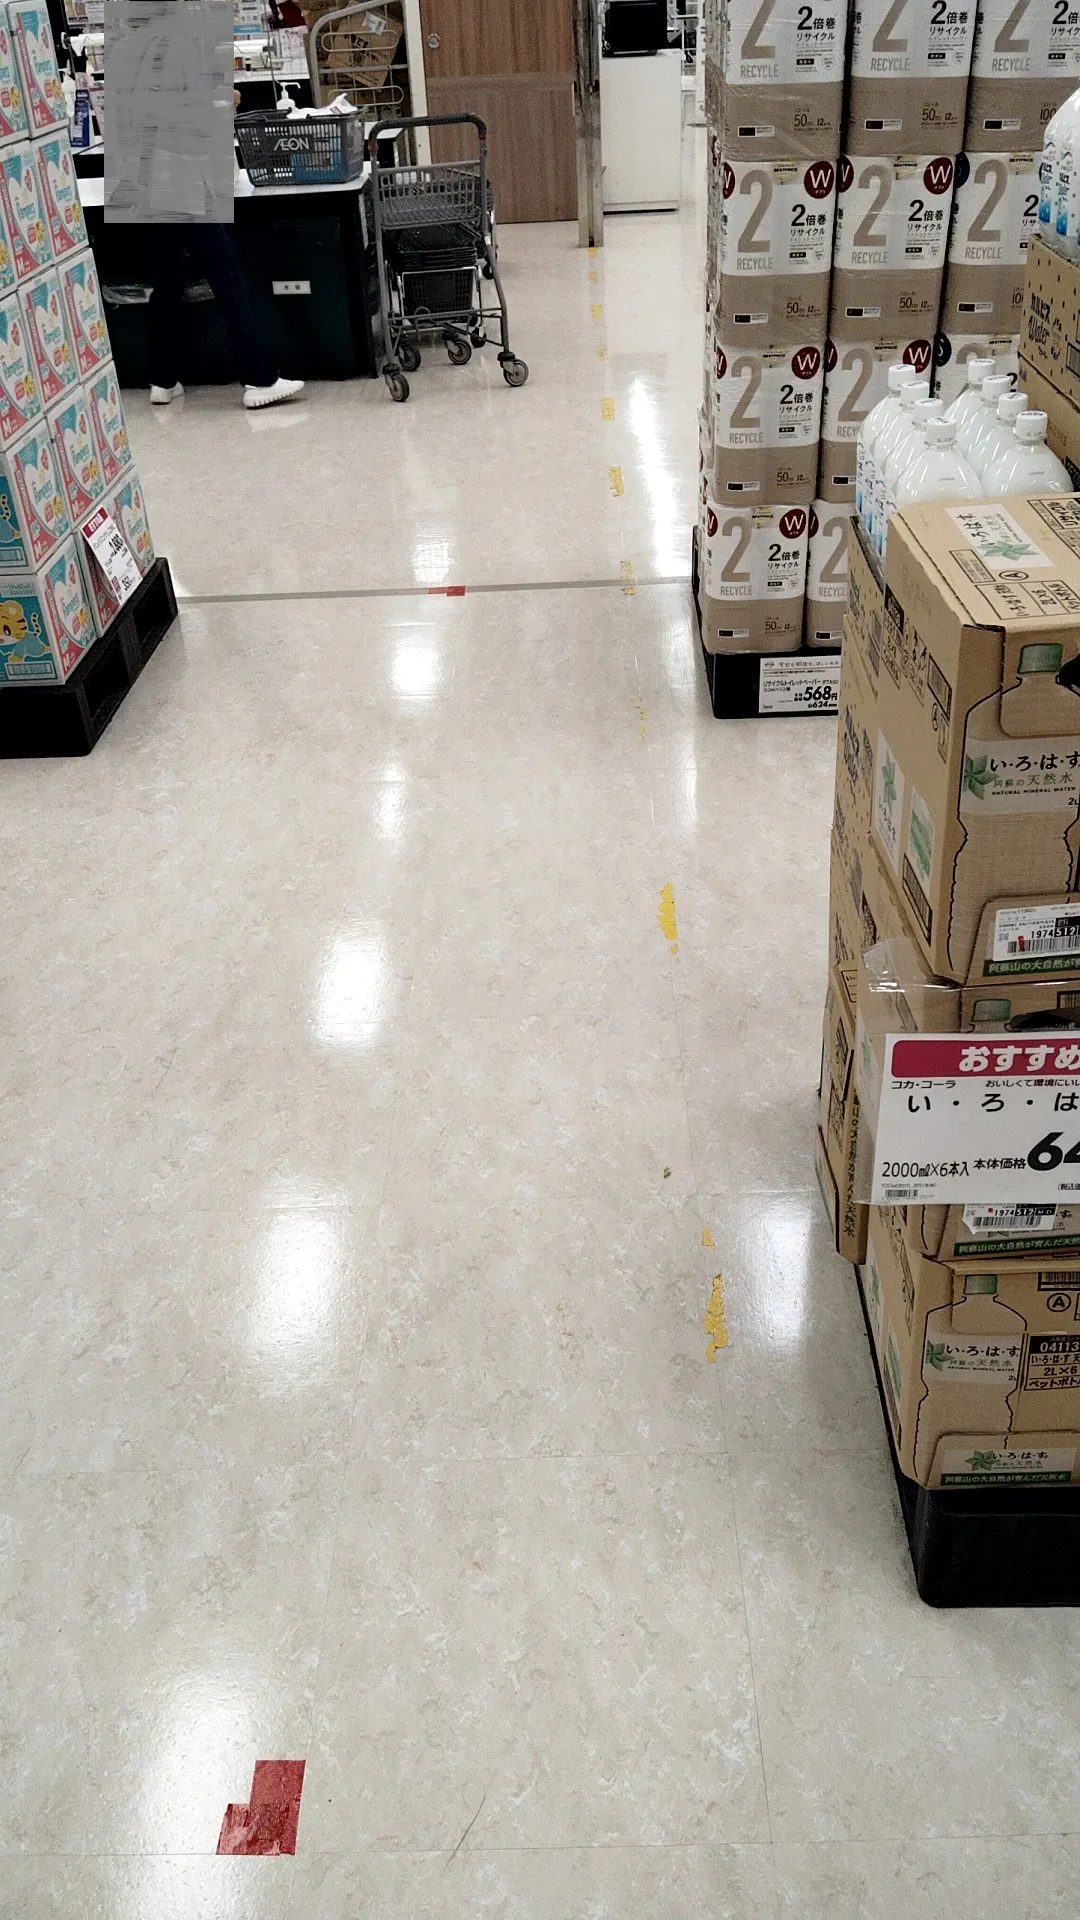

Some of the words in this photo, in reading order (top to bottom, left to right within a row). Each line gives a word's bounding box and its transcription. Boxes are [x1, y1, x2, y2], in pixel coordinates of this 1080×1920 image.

[797, 6, 836, 30] 2倍巻
[931, 0, 968, 25] 2倍巻
[797, 33, 835, 41] リサイクル
[929, 27, 967, 35] リサイクル
[740, 64, 779, 78] RECYCLE
[870, 58, 910, 71] RECYCLE
[992, 58, 1031, 71] RECYCLE
[809, 169, 831, 188] W
[930, 165, 951, 184] W
[853, 164, 892, 246] 2
[967, 159, 1008, 242] 2
[738, 170, 773, 253] 2
[791, 204, 827, 226] 2倍巻
[908, 199, 944, 221] 2倍巻
[790, 228, 825, 237] リサイクル
[907, 223, 942, 232] リサイクル
[852, 251, 889, 264] RECYCLE
[965, 247, 1002, 259] RECYCLE
[736, 258, 773, 270] RECYCLE
[797, 352, 817, 370] W
[908, 346, 929, 364] W
[730, 355, 762, 429] 2
[838, 348, 873, 422] 2
[779, 384, 813, 405] 2倍巻
[779, 405, 812, 414] リサイクル
[729, 432, 764, 444] RECYCLE
[836, 425, 859, 438] RECY
[784, 514, 804, 531] W
[720, 516, 751, 582] 2
[768, 543, 800, 562] 2倍巻
[820, 517, 850, 583] 2
[767, 561, 799, 569] リサイクル
[720, 585, 753, 596] RECYCLE
[818, 586, 847, 597] RECYCL
[959, 1044, 1080, 1072] おすすめ
[891, 1080, 956, 1089] コカ・コーラ
[973, 1158, 1026, 1170] 本体価格
[946, 1345, 1021, 1357] い・ろ・は・す
